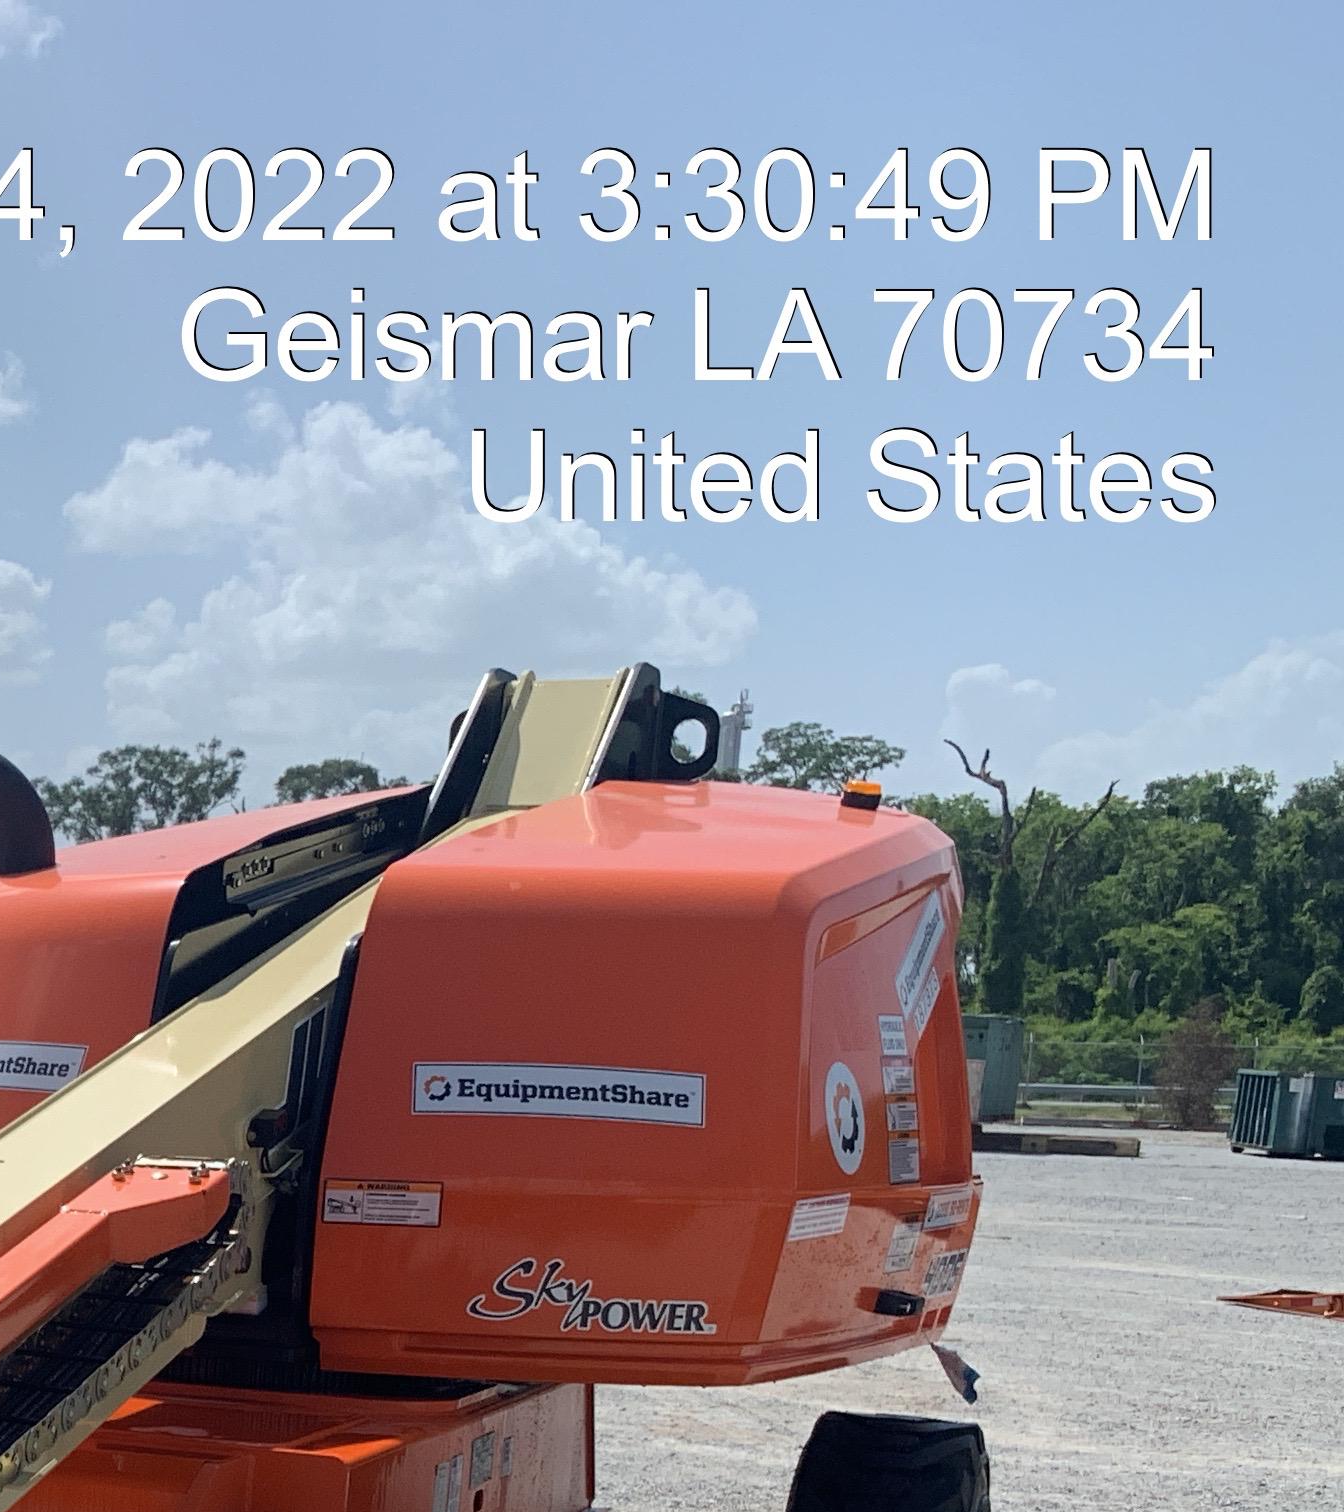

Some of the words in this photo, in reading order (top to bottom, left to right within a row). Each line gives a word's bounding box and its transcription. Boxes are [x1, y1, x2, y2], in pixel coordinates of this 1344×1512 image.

[456, 1077, 690, 1109] EquipmentShare
[466, 1258, 592, 1331] Sky
[578, 1300, 708, 1332] POWER
